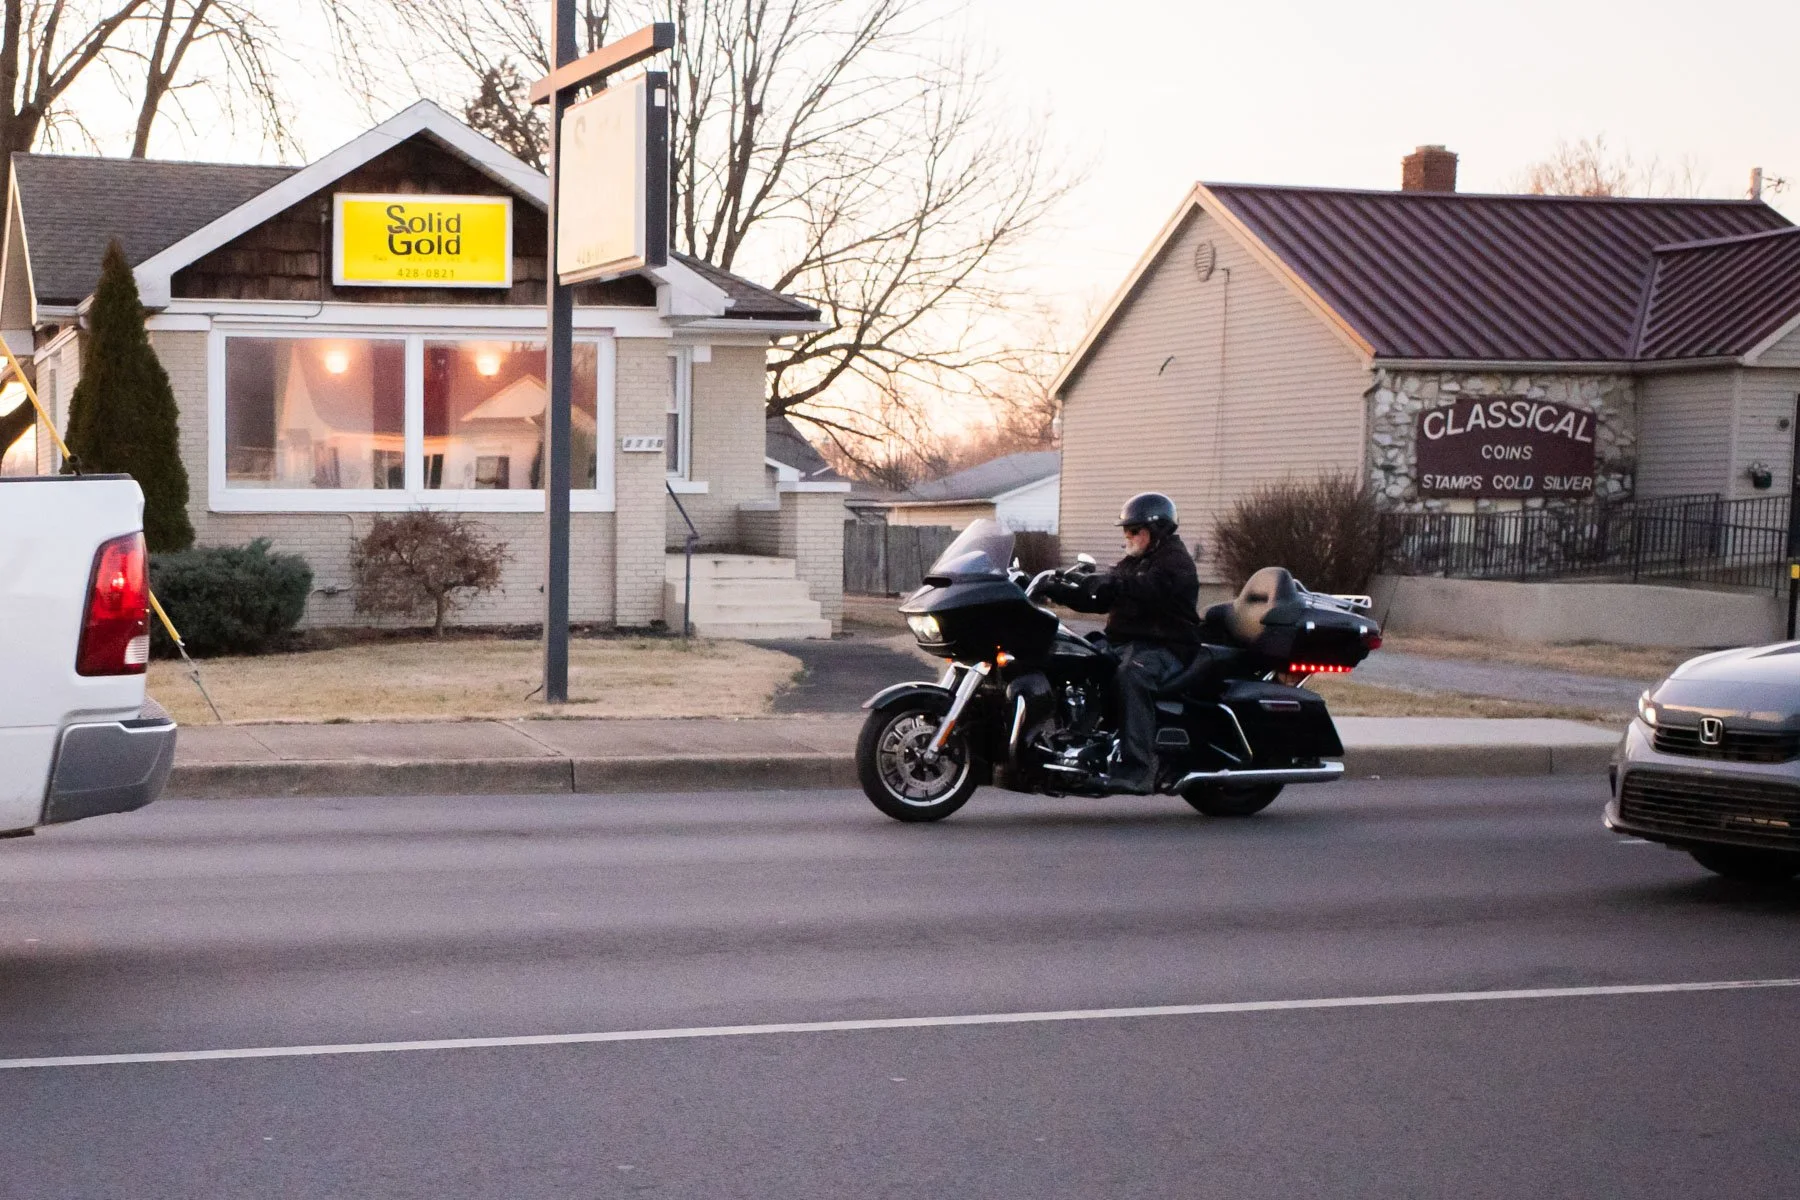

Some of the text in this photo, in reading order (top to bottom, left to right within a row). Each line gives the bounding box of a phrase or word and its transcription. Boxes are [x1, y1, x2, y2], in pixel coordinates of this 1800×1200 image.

[386, 205, 461, 234] Solid
[387, 230, 461, 256] Gold
[397, 268, 455, 278] 428-0821
[1423, 401, 1592, 443] CLASSICAL
[1481, 444, 1533, 460] COINS
[1422, 474, 1483, 490] STAMPS
[1543, 476, 1592, 491] SILVER
